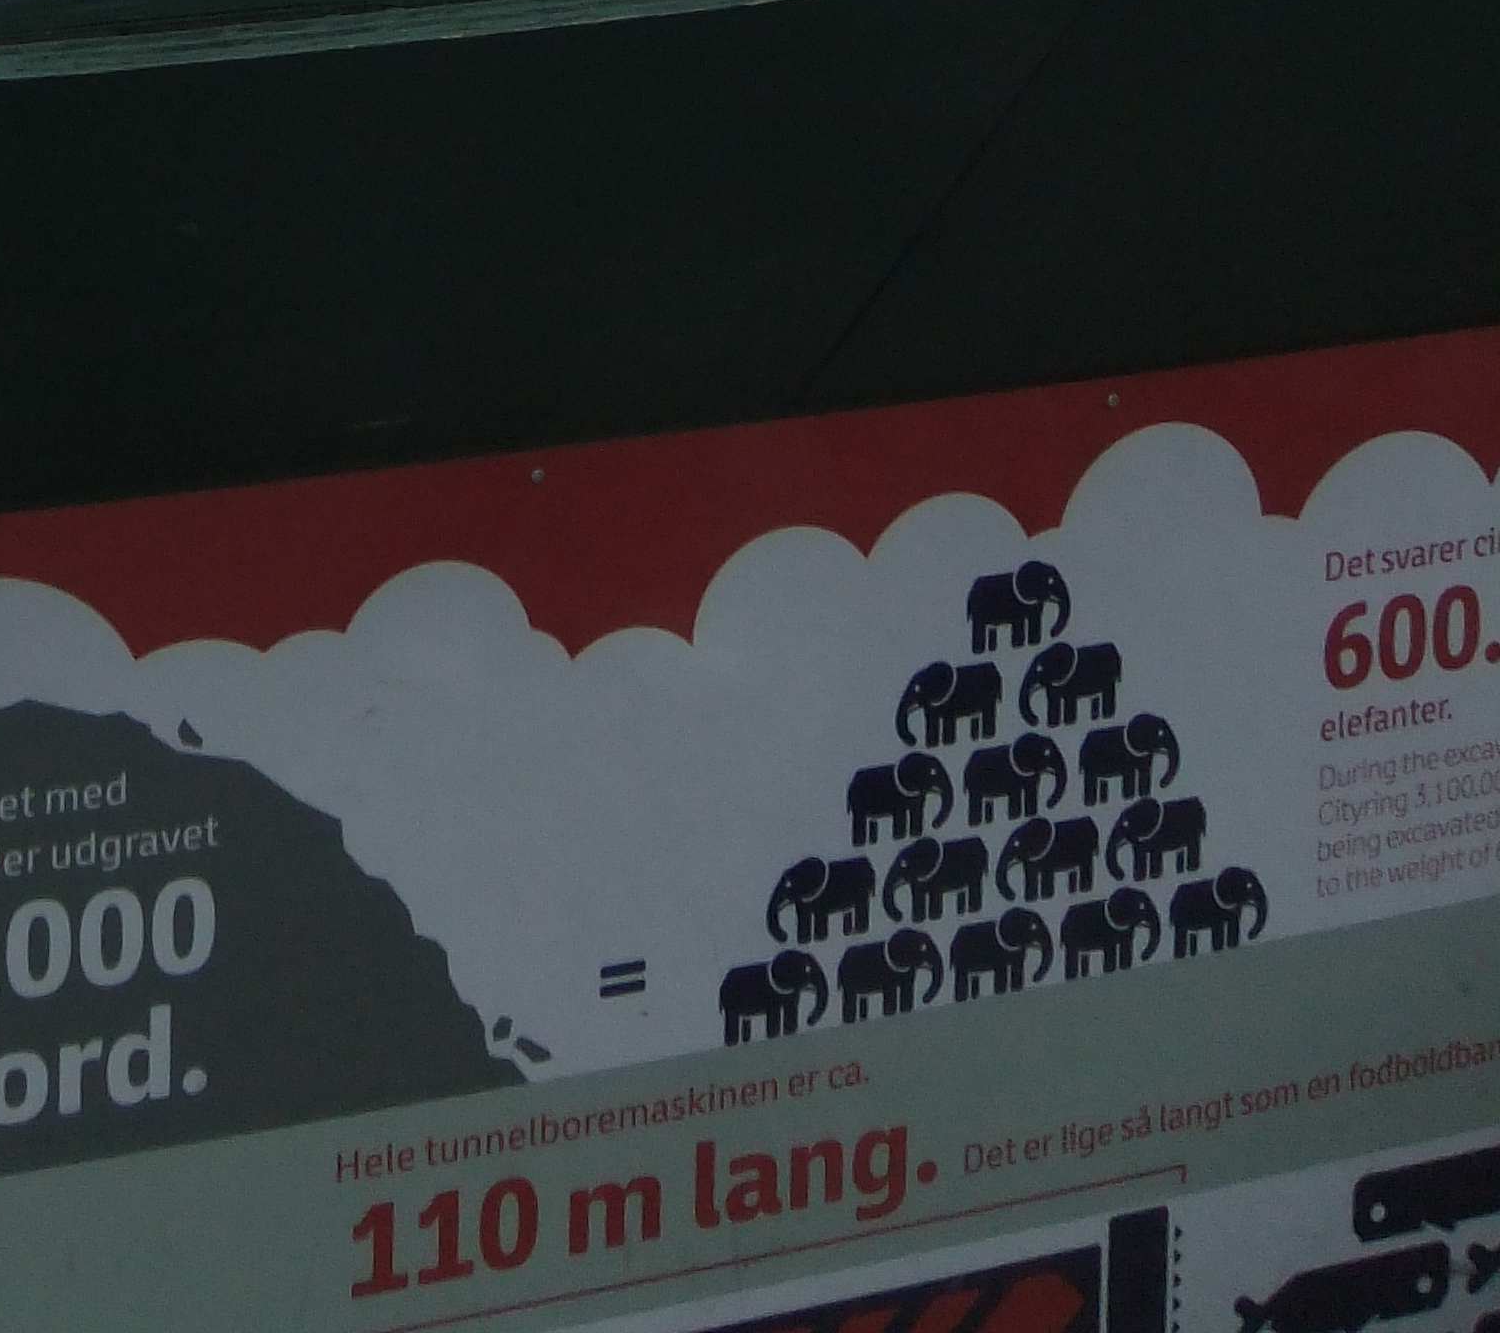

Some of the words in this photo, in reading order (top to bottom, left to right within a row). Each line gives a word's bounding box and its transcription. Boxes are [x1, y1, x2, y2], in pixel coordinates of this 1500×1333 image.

[1324, 549, 1376, 583] Det
[1381, 535, 1470, 572] svarer
[1473, 527, 1500, 558] ci
[1322, 584, 1500, 690] 600.
[1319, 697, 1453, 742] elefanter.
[45, 772, 128, 816] med
[1318, 759, 1396, 791] During
[1402, 750, 1439, 775] the
[1318, 792, 1409, 827] Cityring
[50, 816, 220, 876] udgravet
[1317, 832, 1382, 862] being
[1317, 875, 1341, 899] to
[1346, 867, 1383, 892] the
[1387, 850, 1466, 882] weight
[335, 1143, 414, 1183] Hele
[426, 1075, 780, 1167] tunnelboremaskinen
[787, 1068, 820, 1098] er
[827, 1060, 871, 1090] ca.
[963, 1139, 1017, 1176] Det
[1023, 1137, 1056, 1163] er
[1060, 1121, 1114, 1160] lige
[1120, 1105, 1155, 1143] så
[1160, 1091, 1235, 1136] langt
[1240, 1080, 1301, 1117] som
[350, 1176, 540, 1299] 110
[567, 1173, 663, 1257] m
[695, 1124, 940, 1227] lang.
